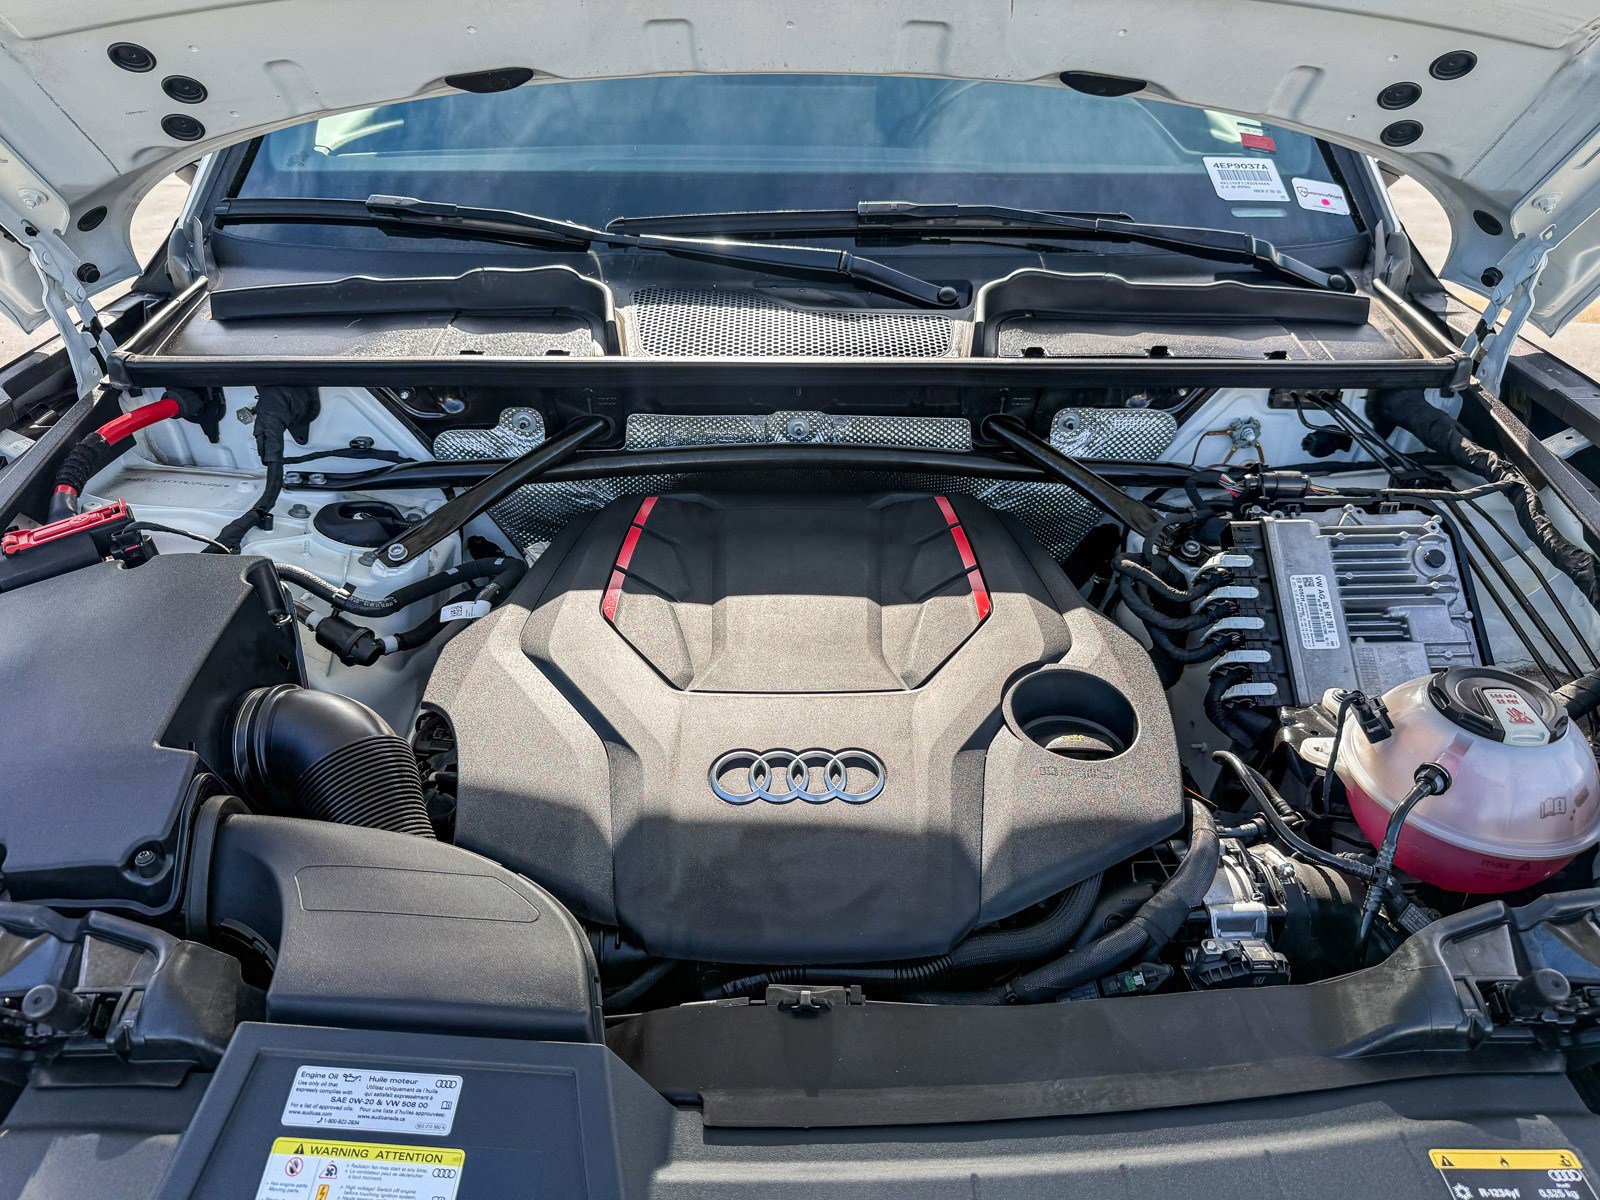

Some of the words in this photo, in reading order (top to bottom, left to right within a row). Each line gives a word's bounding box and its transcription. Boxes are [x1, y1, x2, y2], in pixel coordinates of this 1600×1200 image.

[1213, 162, 1268, 170] 4EP9037A
[1315, 576, 1323, 588] VW
[1318, 589, 1325, 600] AG
[301, 1071, 326, 1079] Engine
[310, 1146, 369, 1158] WARNING
[375, 1150, 443, 1163] ATTENTION
[1478, 1188, 1520, 1200] R-1234yf
[1565, 1189, 1580, 1200] kg
